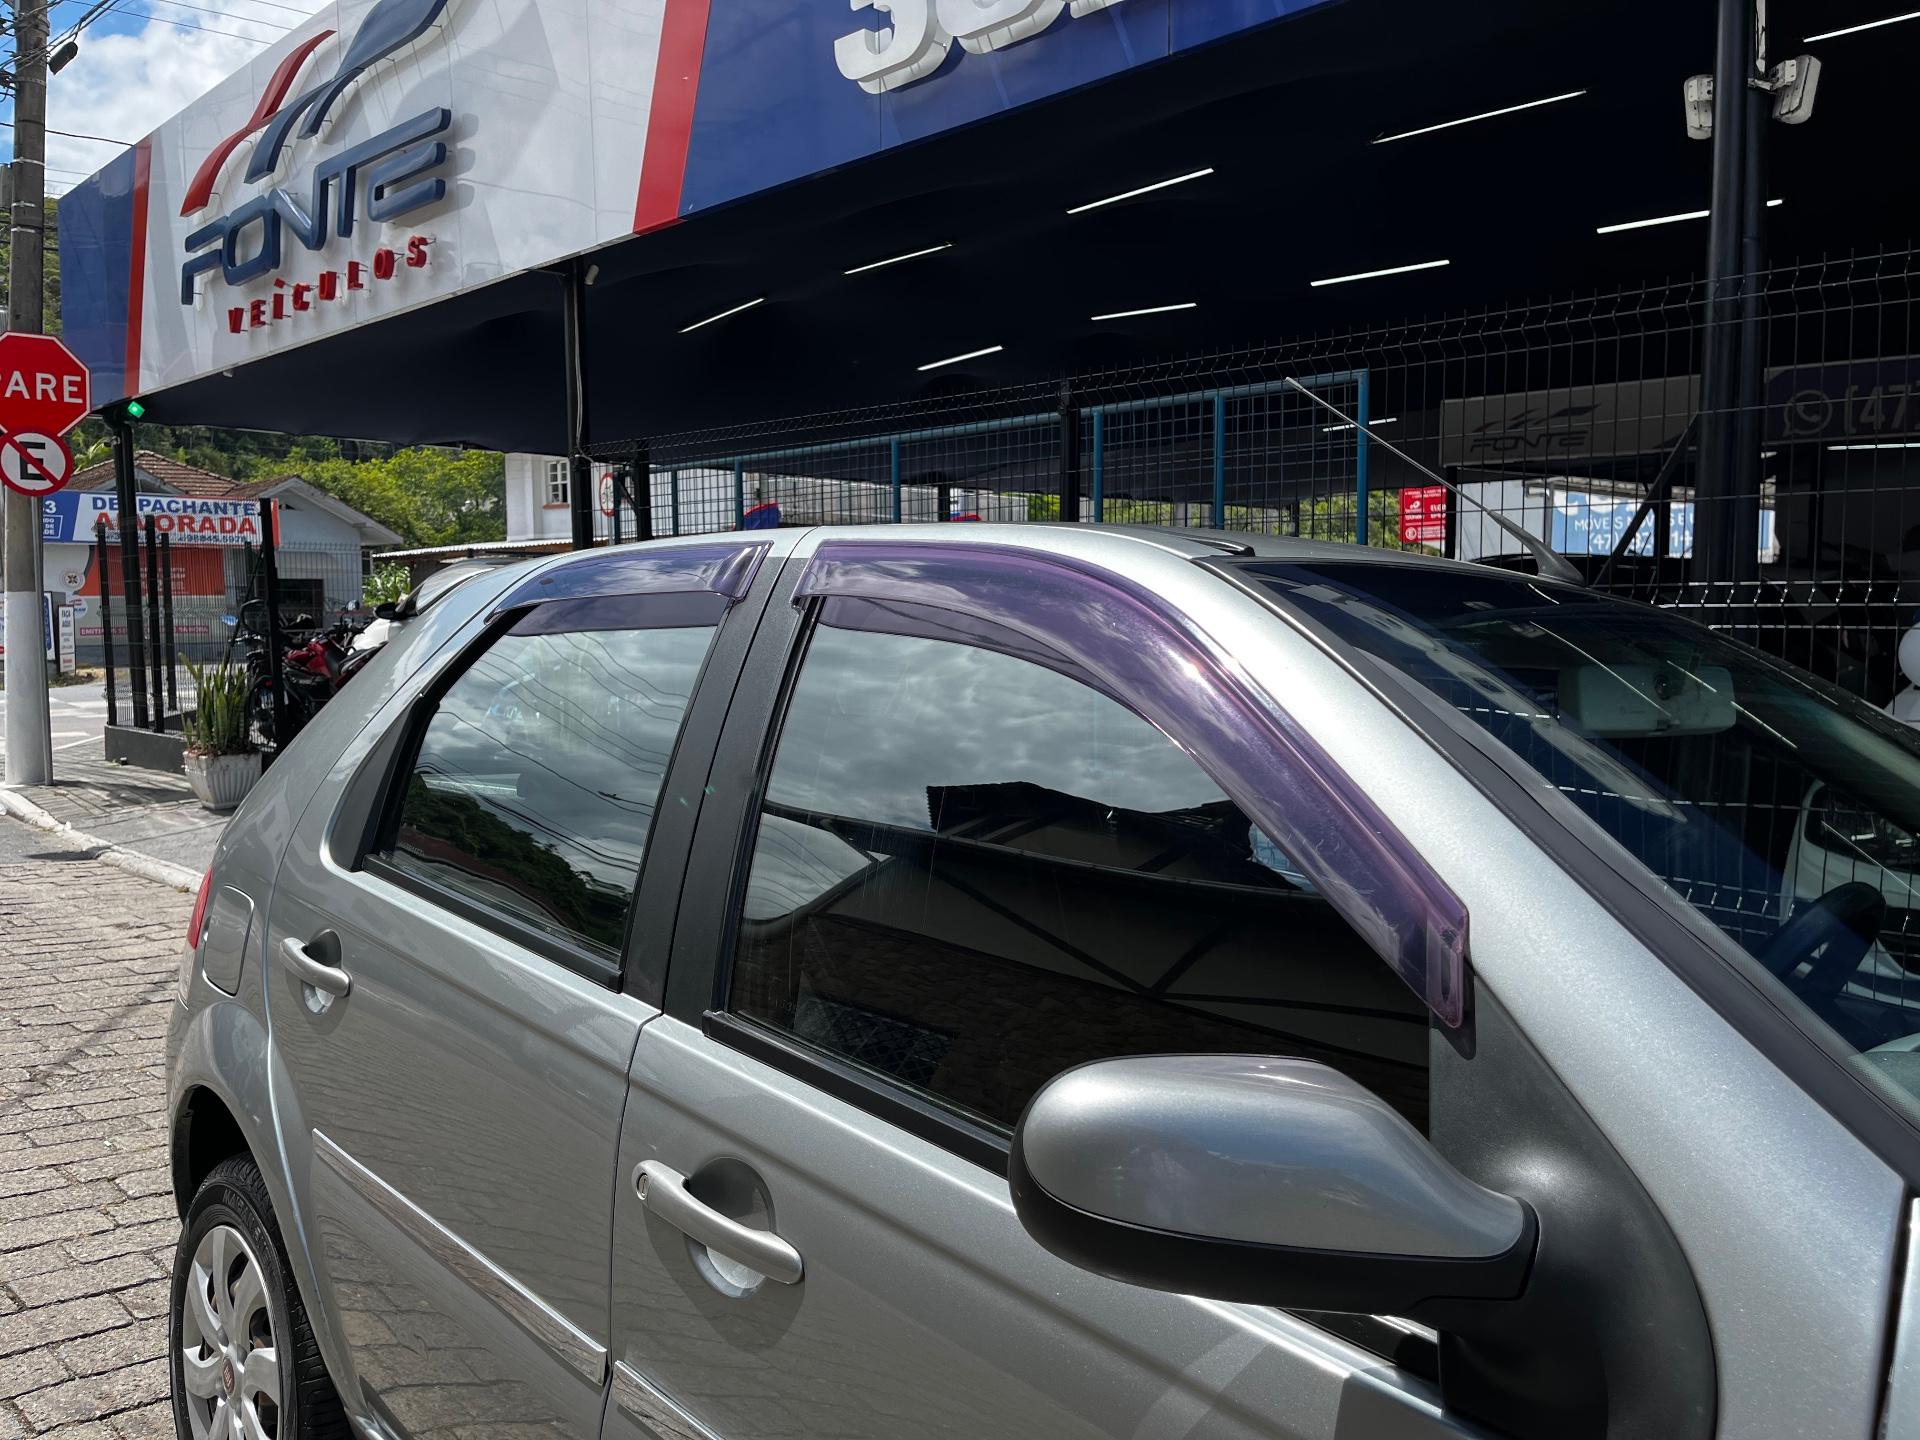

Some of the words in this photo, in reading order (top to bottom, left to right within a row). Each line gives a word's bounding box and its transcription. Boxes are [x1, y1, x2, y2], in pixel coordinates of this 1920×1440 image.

[181, 106, 452, 305] FONTE
[228, 235, 430, 334] VEÍCULOS
[0, 369, 83, 404] ARE
[1470, 430, 1588, 453] FONTE
[92, 496, 258, 516] DEPACHANTE
